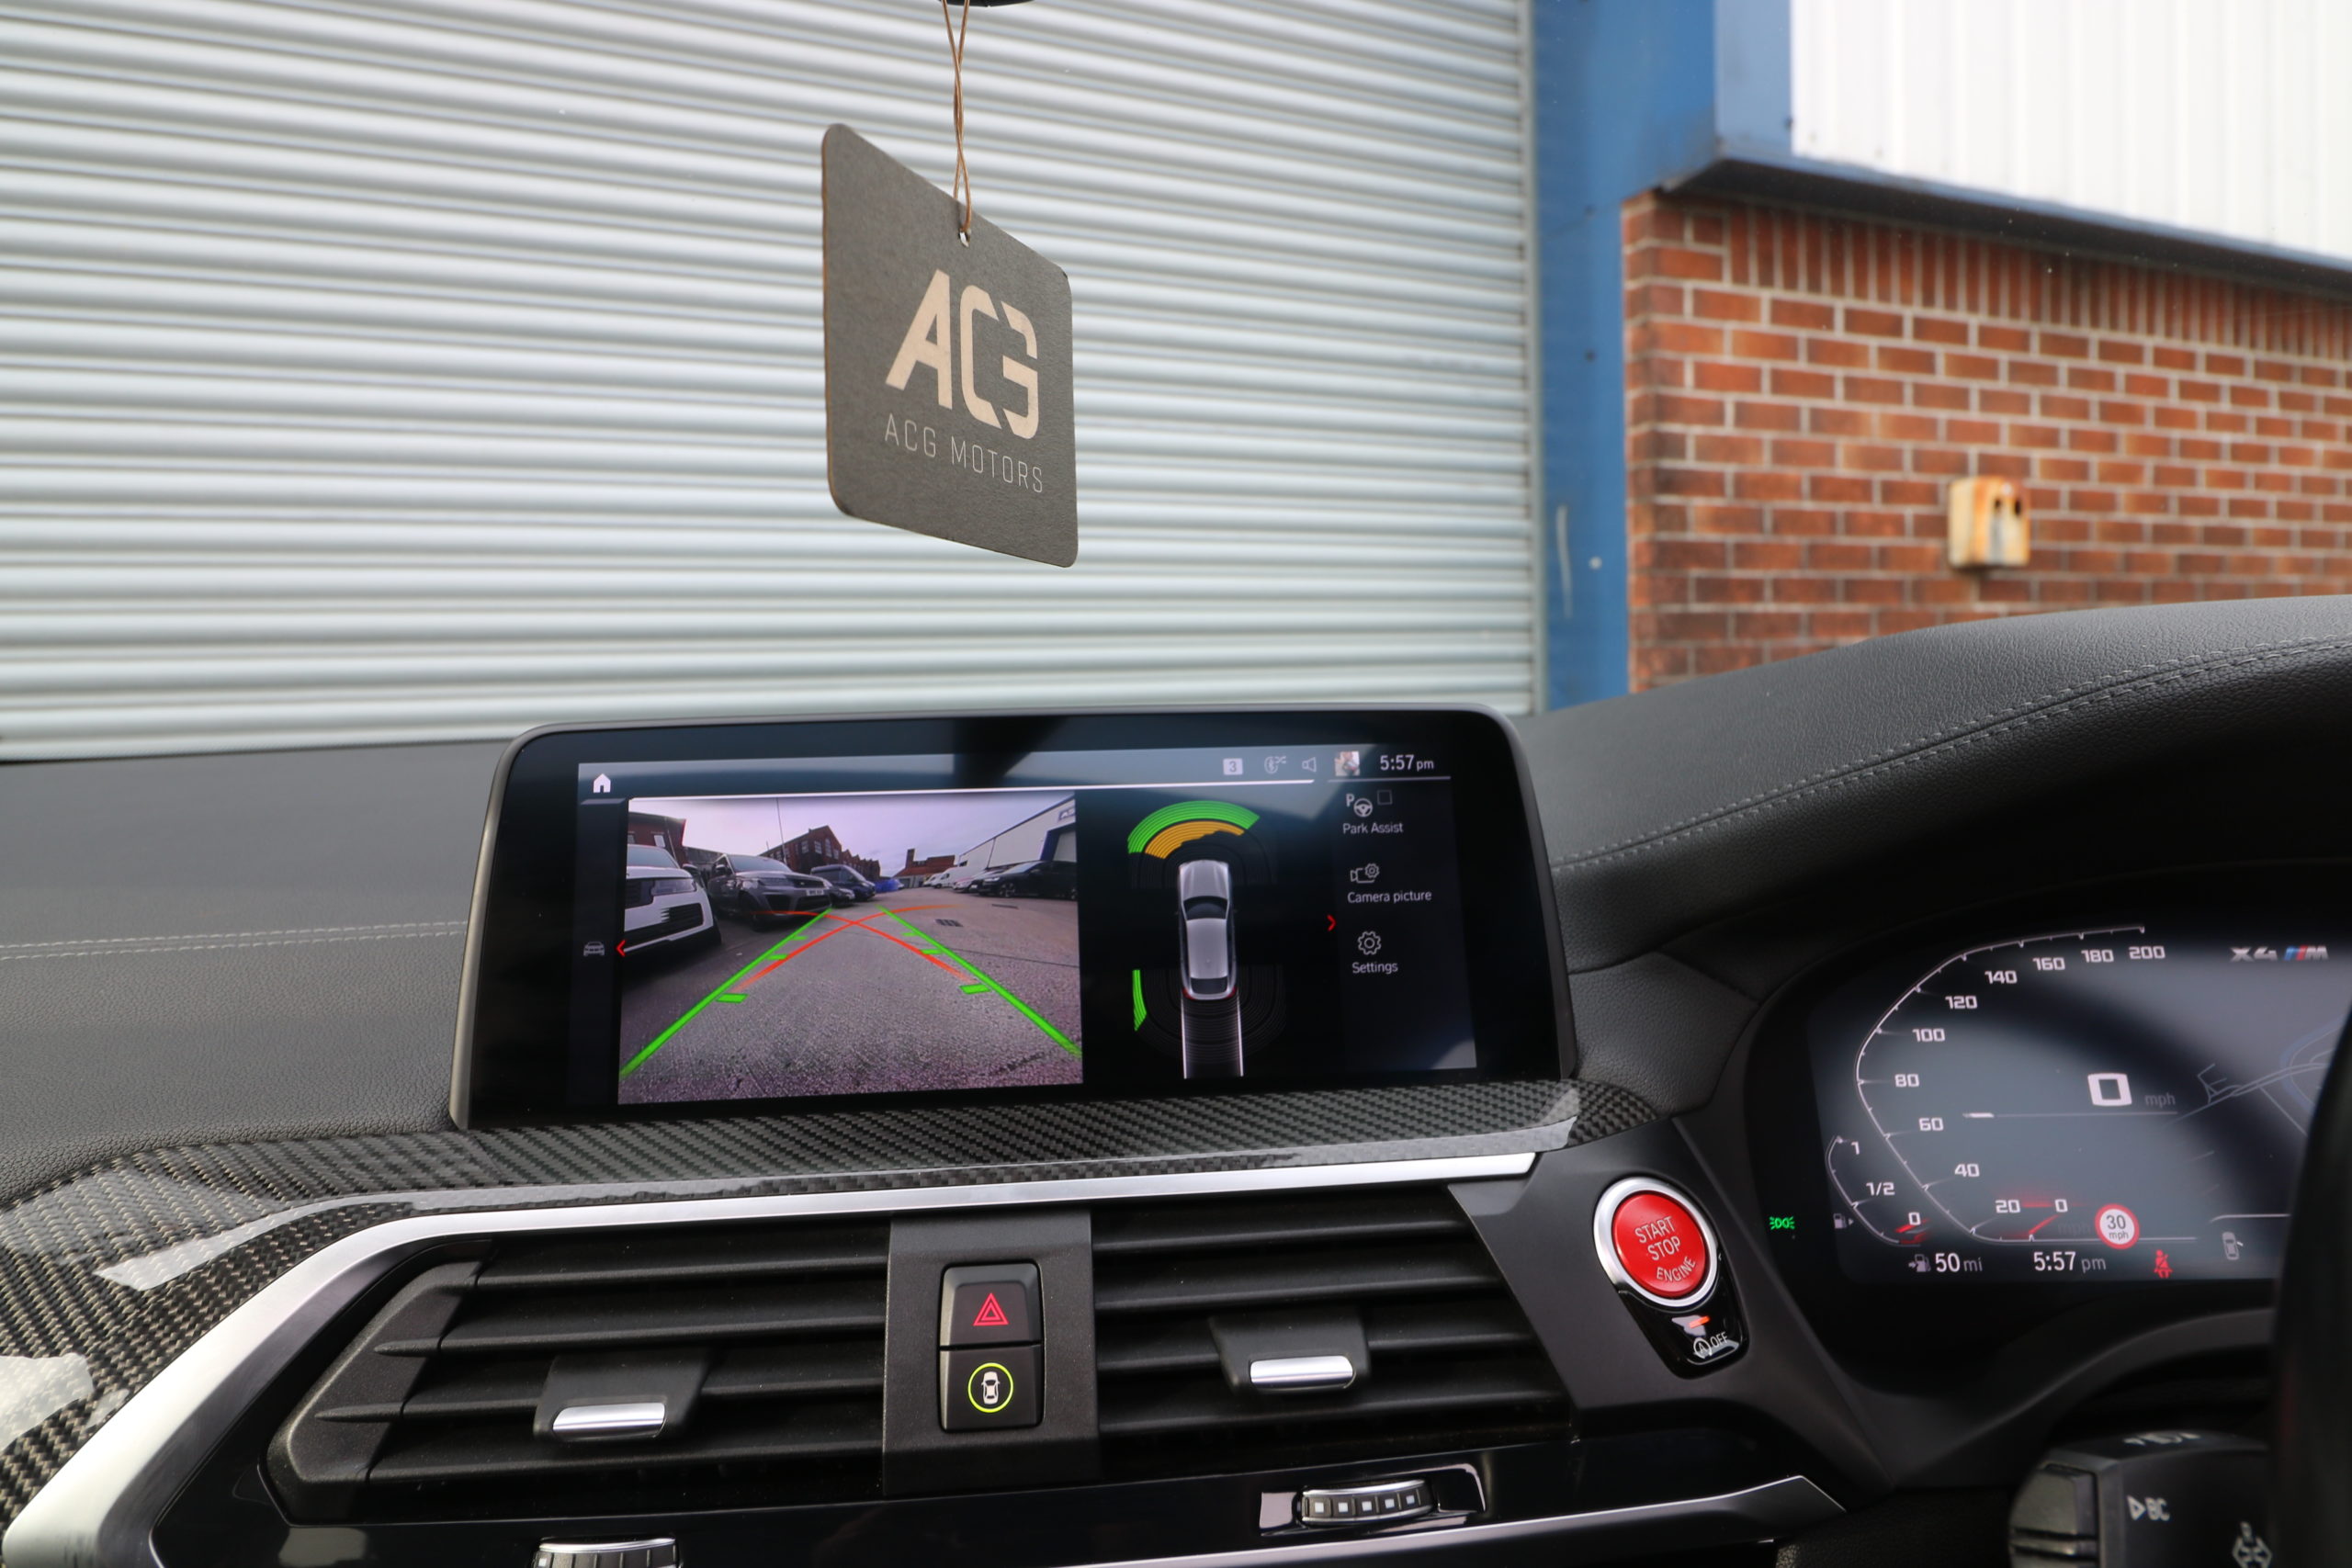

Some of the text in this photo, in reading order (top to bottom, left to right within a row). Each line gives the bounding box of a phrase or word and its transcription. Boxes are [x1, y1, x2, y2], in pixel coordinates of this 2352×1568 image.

[886, 269, 1038, 439] ACG
[885, 413, 1043, 493] ACG MOTORS
[1228, 761, 1237, 773] 3
[1342, 822, 1404, 834] Park Assist
[1347, 889, 1432, 904] Camera picture
[2081, 949, 2113, 963] 180
[2129, 945, 2165, 960] 200
[2230, 946, 2278, 962] X4
[1352, 962, 1398, 975] Settings
[2032, 957, 2065, 971] 160
[1984, 970, 2018, 984] 140
[1945, 995, 1977, 1010] 120
[1912, 1028, 1945, 1042] 100
[1894, 1073, 1919, 1088] 80
[2087, 1073, 2176, 1109] 0 mph
[1918, 1117, 1944, 1131] 60
[1851, 1141, 1860, 1155] 1
[1954, 1163, 1980, 1177] 40
[1866, 1182, 1895, 1196] 1/2
[1996, 1200, 2020, 1213] 20
[2054, 1199, 2068, 1213] 0
[1908, 1212, 1921, 1225] 0
[2107, 1214, 2126, 1230] 30
[1634, 1215, 1676, 1244] START
[2109, 1230, 2129, 1241] mph
[1647, 1235, 1681, 1261] STOP
[1657, 1256, 1696, 1282] ENGINE
[1935, 1253, 1983, 1272] 50 mi
[2033, 1251, 2107, 1273] 5:57 pm
[1710, 1331, 1727, 1348] OFF
